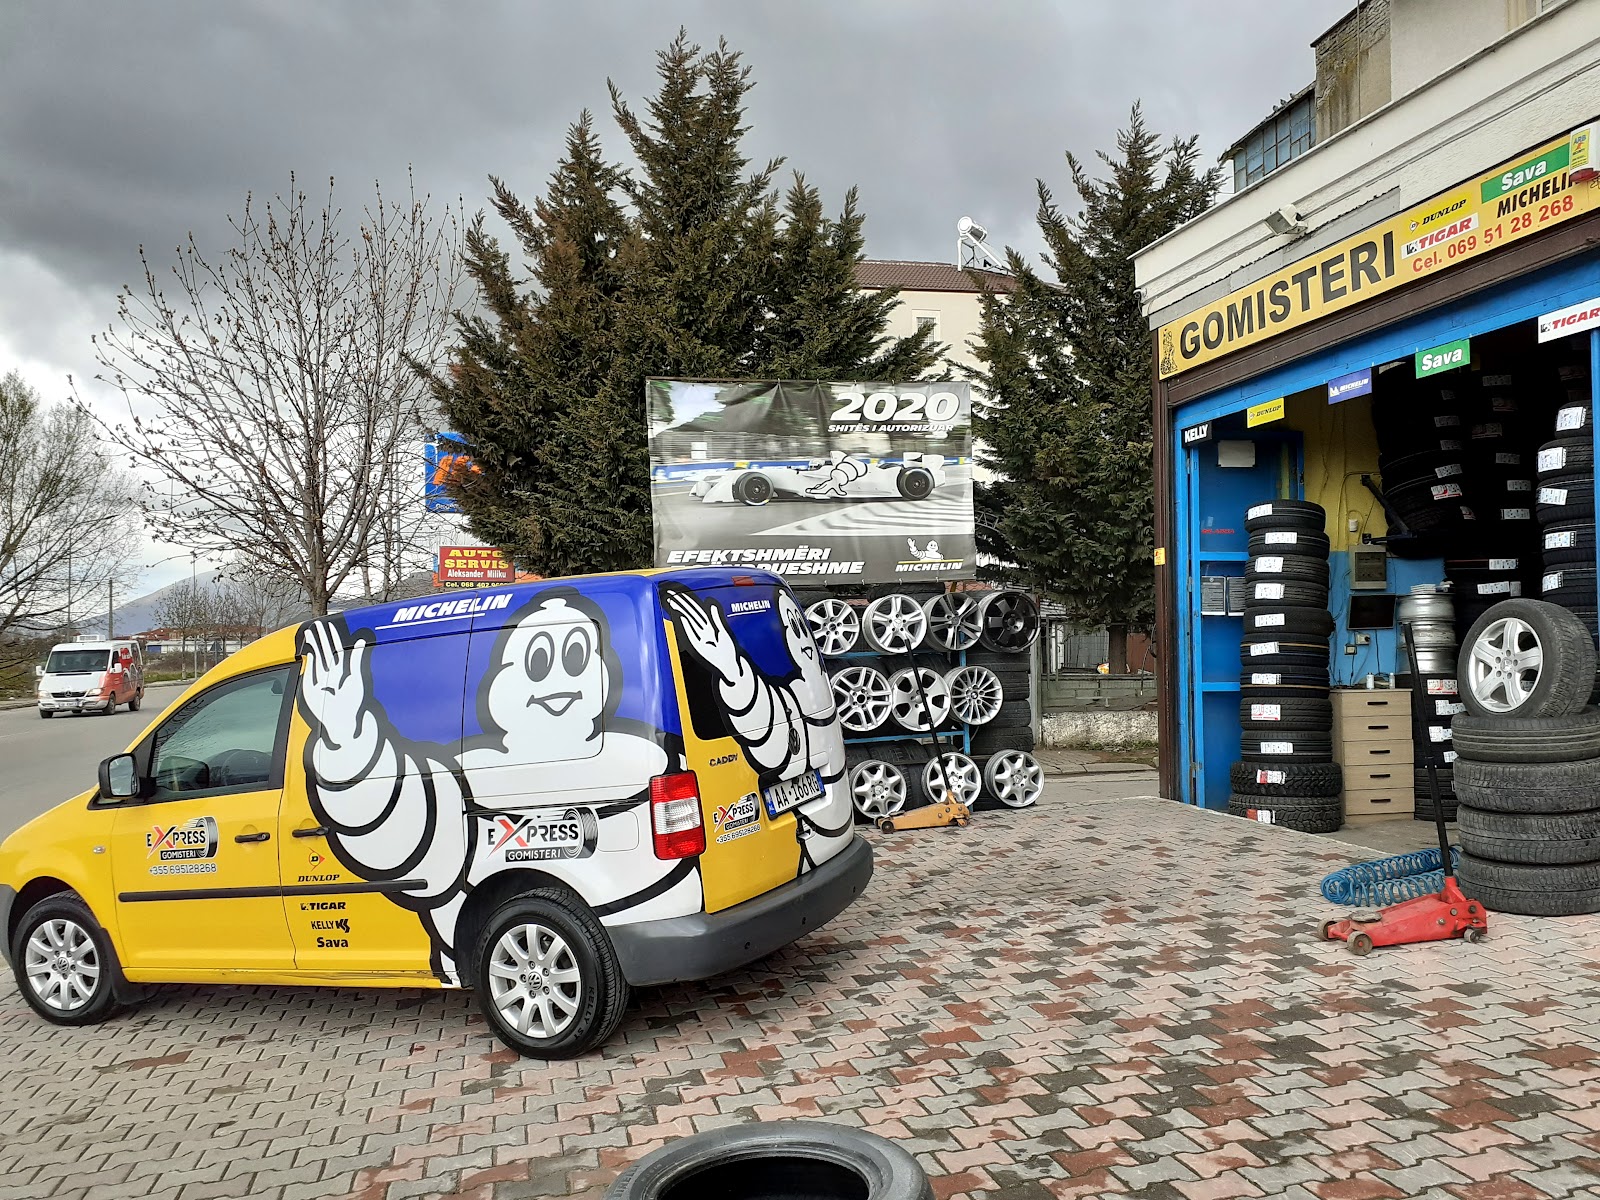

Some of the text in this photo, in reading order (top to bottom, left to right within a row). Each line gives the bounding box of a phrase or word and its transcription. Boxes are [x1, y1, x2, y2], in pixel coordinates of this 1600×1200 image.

[1501, 161, 1547, 191] Sava
[1421, 199, 1467, 226] DUNLOP
[1412, 195, 1574, 273] Cel. 069 51 28 268
[1418, 217, 1473, 250] TIGAR
[1179, 231, 1396, 360] GOMISTERI
[1552, 307, 1600, 330] TIGAR
[1420, 347, 1463, 371] Sava
[1340, 378, 1369, 392] MICHELIN
[829, 392, 960, 422] 2020
[1255, 404, 1282, 418] DUNLOP
[827, 423, 870, 432] SHITËS
[878, 424, 954, 432] AUTORIZUAR
[1184, 424, 1208, 443] KELLY
[666, 545, 832, 563] EFEKTSHMËRI
[444, 559, 509, 569] SERVIS
[895, 561, 964, 573] MICHELIN
[447, 569, 507, 578] Aleksander Miliku
[392, 594, 513, 623] MICHELIN
[730, 600, 771, 613] MICHELIN
[709, 753, 738, 767] CADDY
[774, 785, 790, 808] AA
[162, 850, 197, 860] GOMISTERI
[508, 849, 560, 861] GOMISTERI
[169, 863, 217, 874] 695128268
[297, 874, 340, 882] DUNLOP
[309, 901, 346, 910] TIGAR
[310, 920, 334, 930] KELLY
[317, 936, 349, 948] Sava
